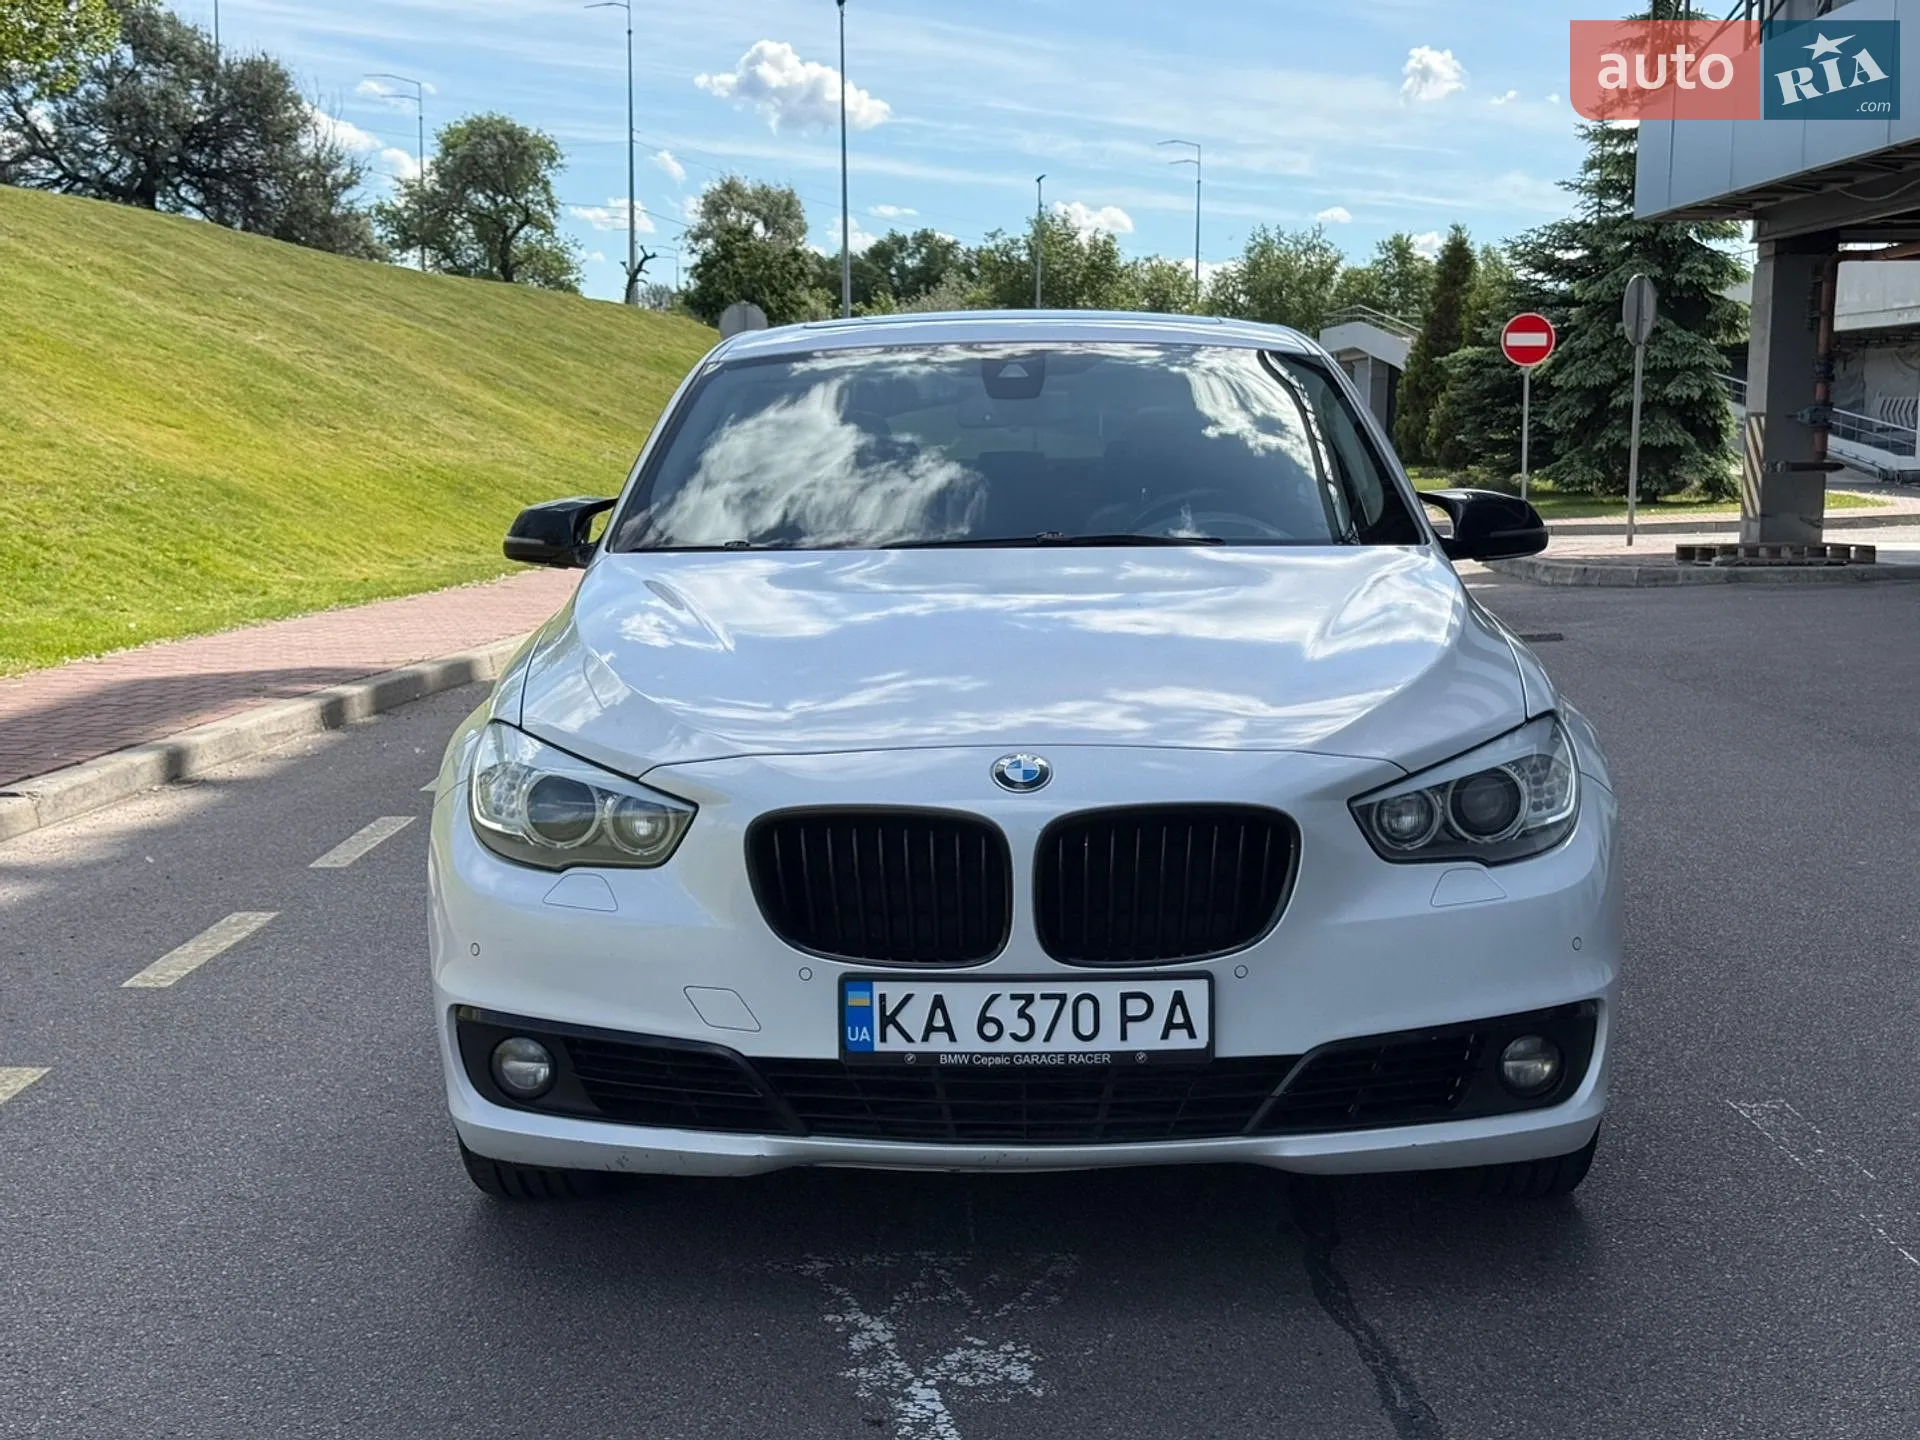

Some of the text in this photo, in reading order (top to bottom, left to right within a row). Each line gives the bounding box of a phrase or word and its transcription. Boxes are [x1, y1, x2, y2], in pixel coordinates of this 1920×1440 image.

[878, 990, 1197, 1043] KA 6370 PA
[847, 1026, 871, 1041] UA
[939, 1054, 970, 1065] BMW
[1013, 1053, 1065, 1065] GARAGE
[1068, 1052, 1112, 1064] RACER
